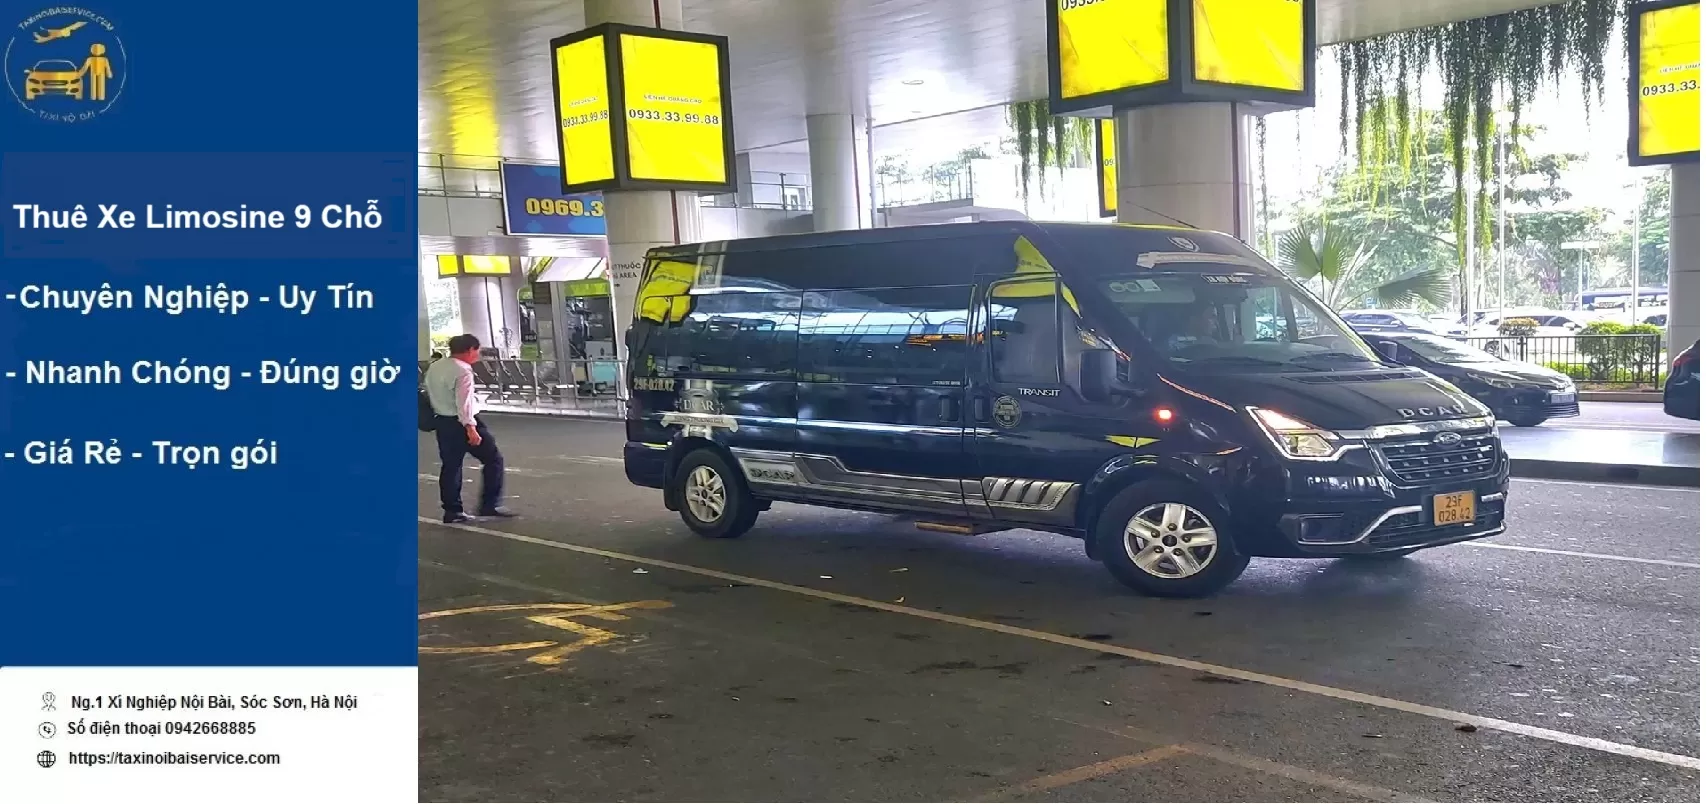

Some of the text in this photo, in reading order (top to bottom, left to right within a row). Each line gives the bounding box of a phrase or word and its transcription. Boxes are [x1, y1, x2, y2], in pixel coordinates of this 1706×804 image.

[1642, 79, 1700, 97] 0933.33.
[562, 110, 609, 128] 0933.33.99.88
[628, 109, 719, 125] 0933.33.99.88
[526, 198, 604, 217] 0969.3
[1017, 387, 1061, 397] TRANSIT
[1445, 494, 1463, 509] 29F
[1438, 507, 1472, 523] 028.42
